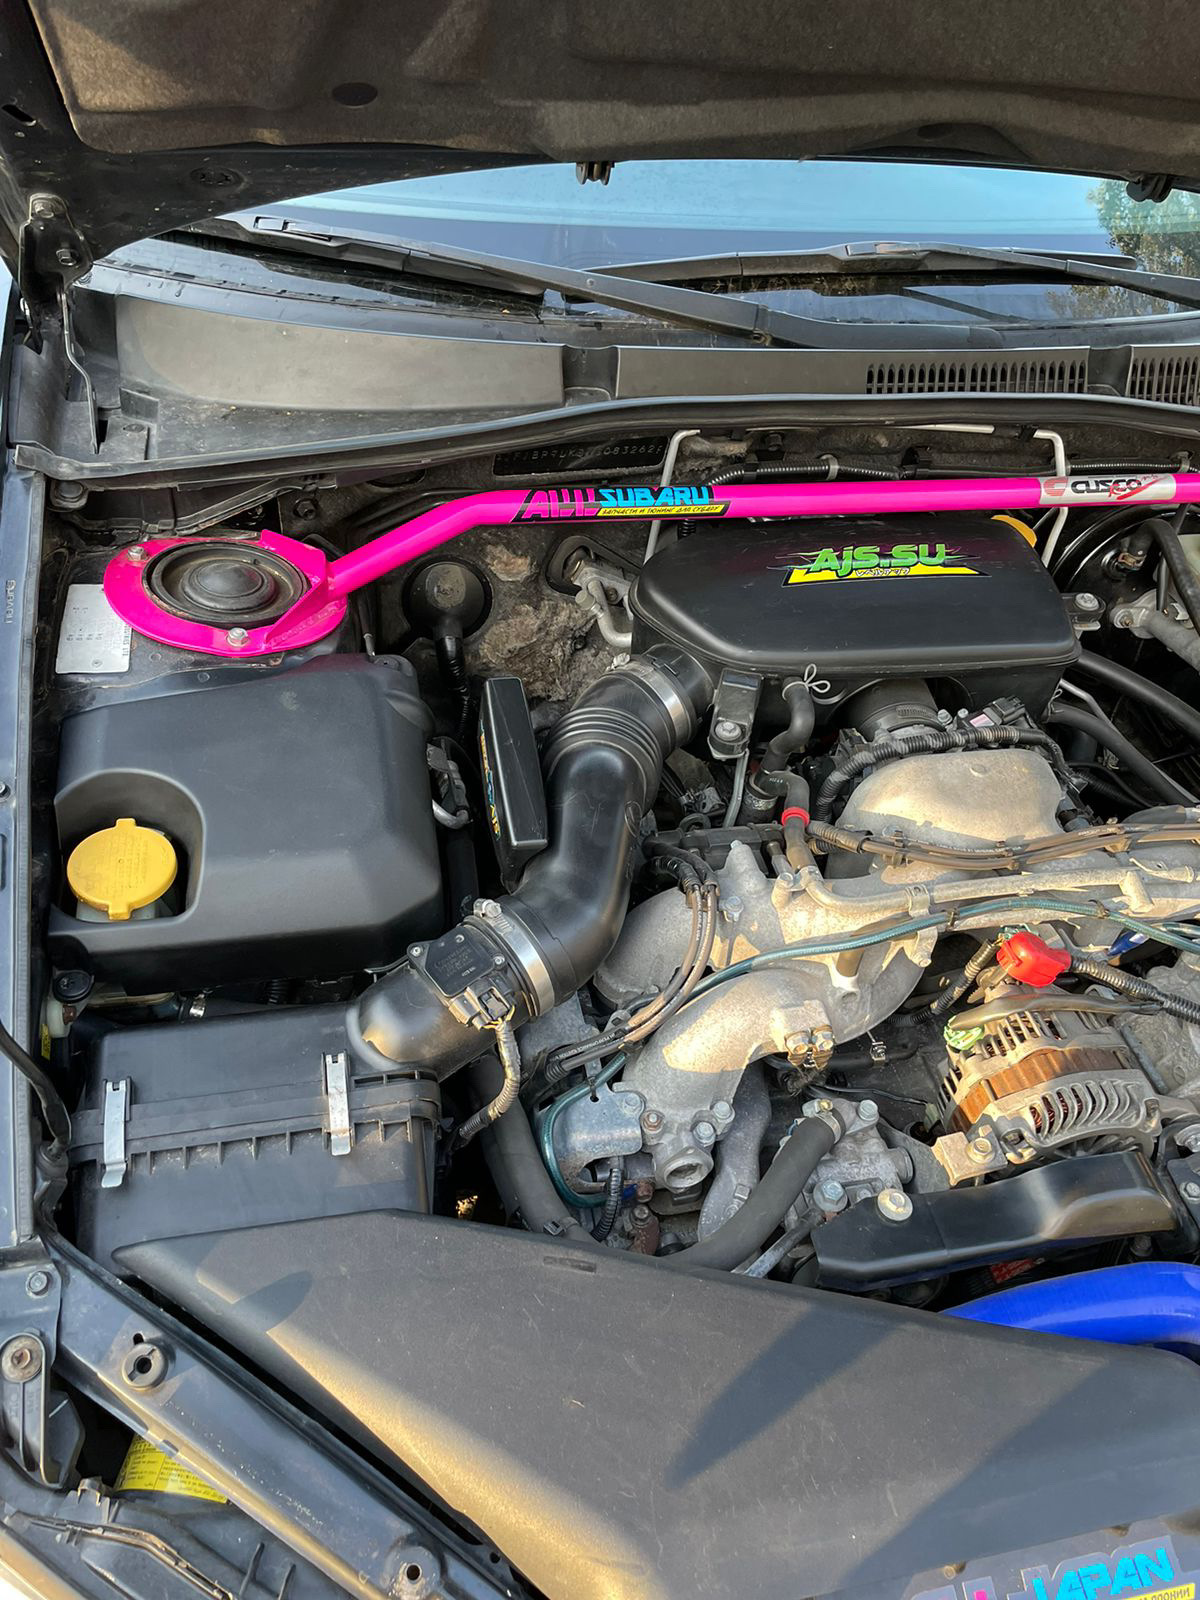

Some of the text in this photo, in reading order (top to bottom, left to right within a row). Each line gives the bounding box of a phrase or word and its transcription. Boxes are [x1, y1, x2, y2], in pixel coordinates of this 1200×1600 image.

[1070, 478, 1142, 494] CUSCO
[521, 486, 710, 518] ALL SUBARU
